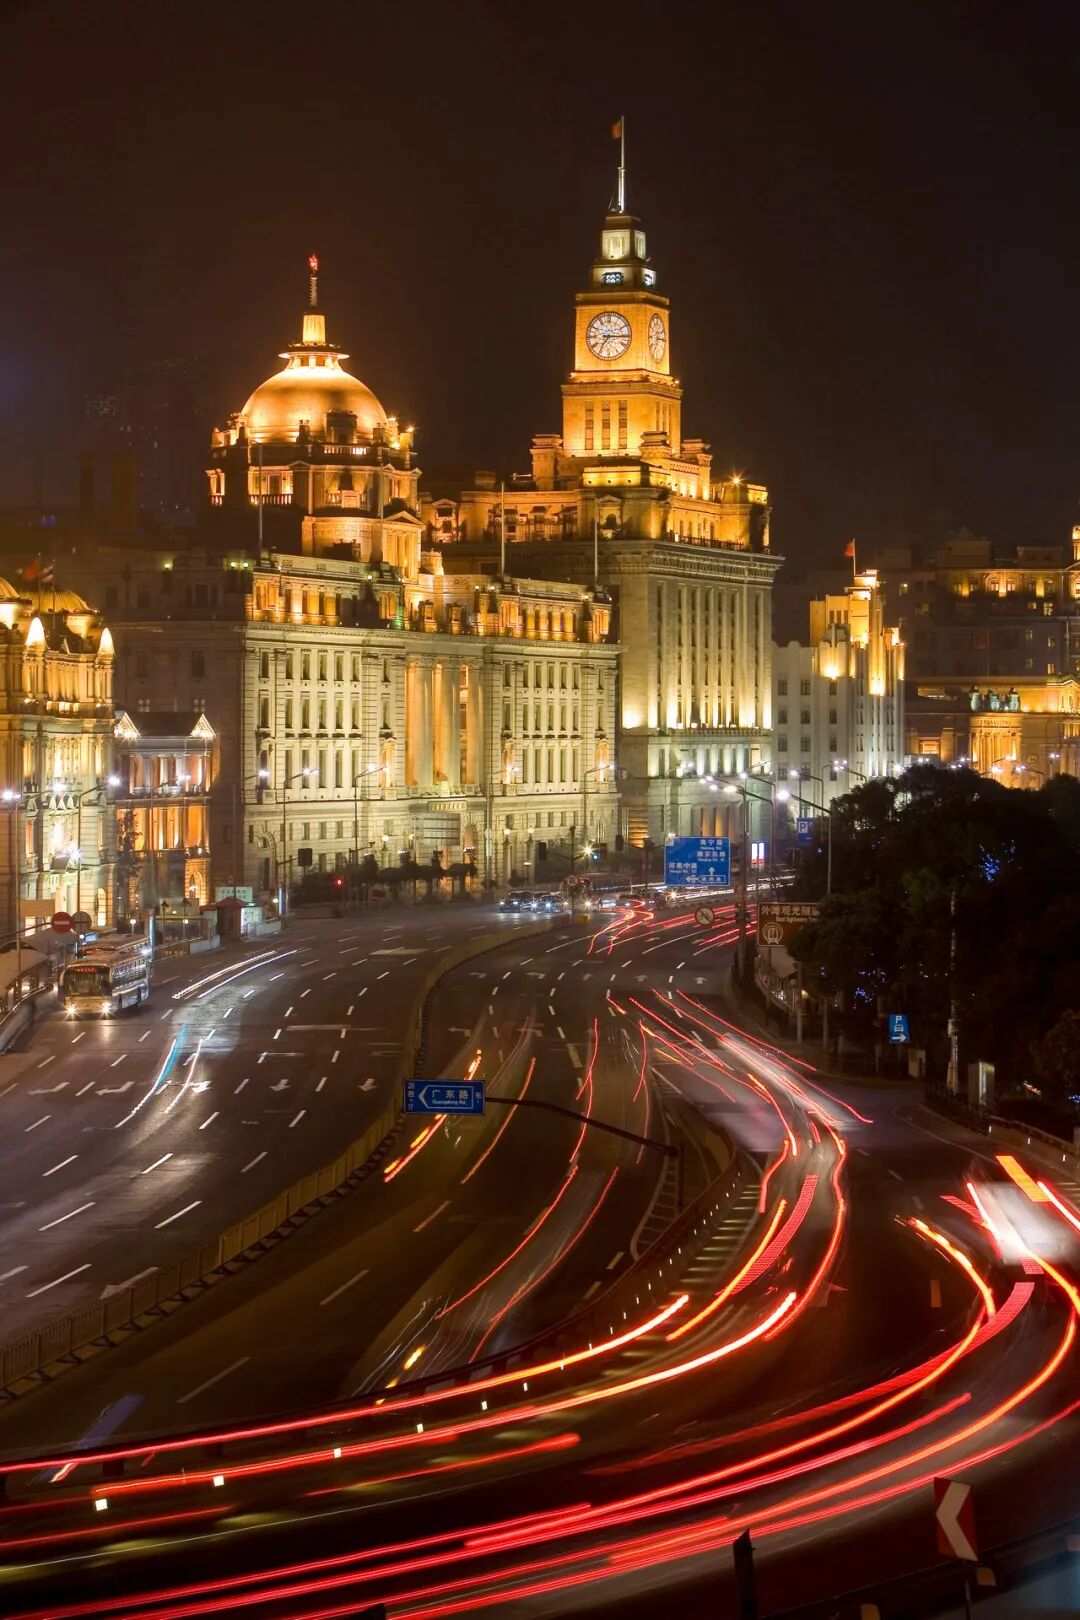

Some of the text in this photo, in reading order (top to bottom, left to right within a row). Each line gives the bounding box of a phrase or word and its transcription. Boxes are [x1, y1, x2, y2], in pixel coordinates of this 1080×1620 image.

[896, 1015, 902, 1024] P
[432, 1089, 468, 1100] 广东路
